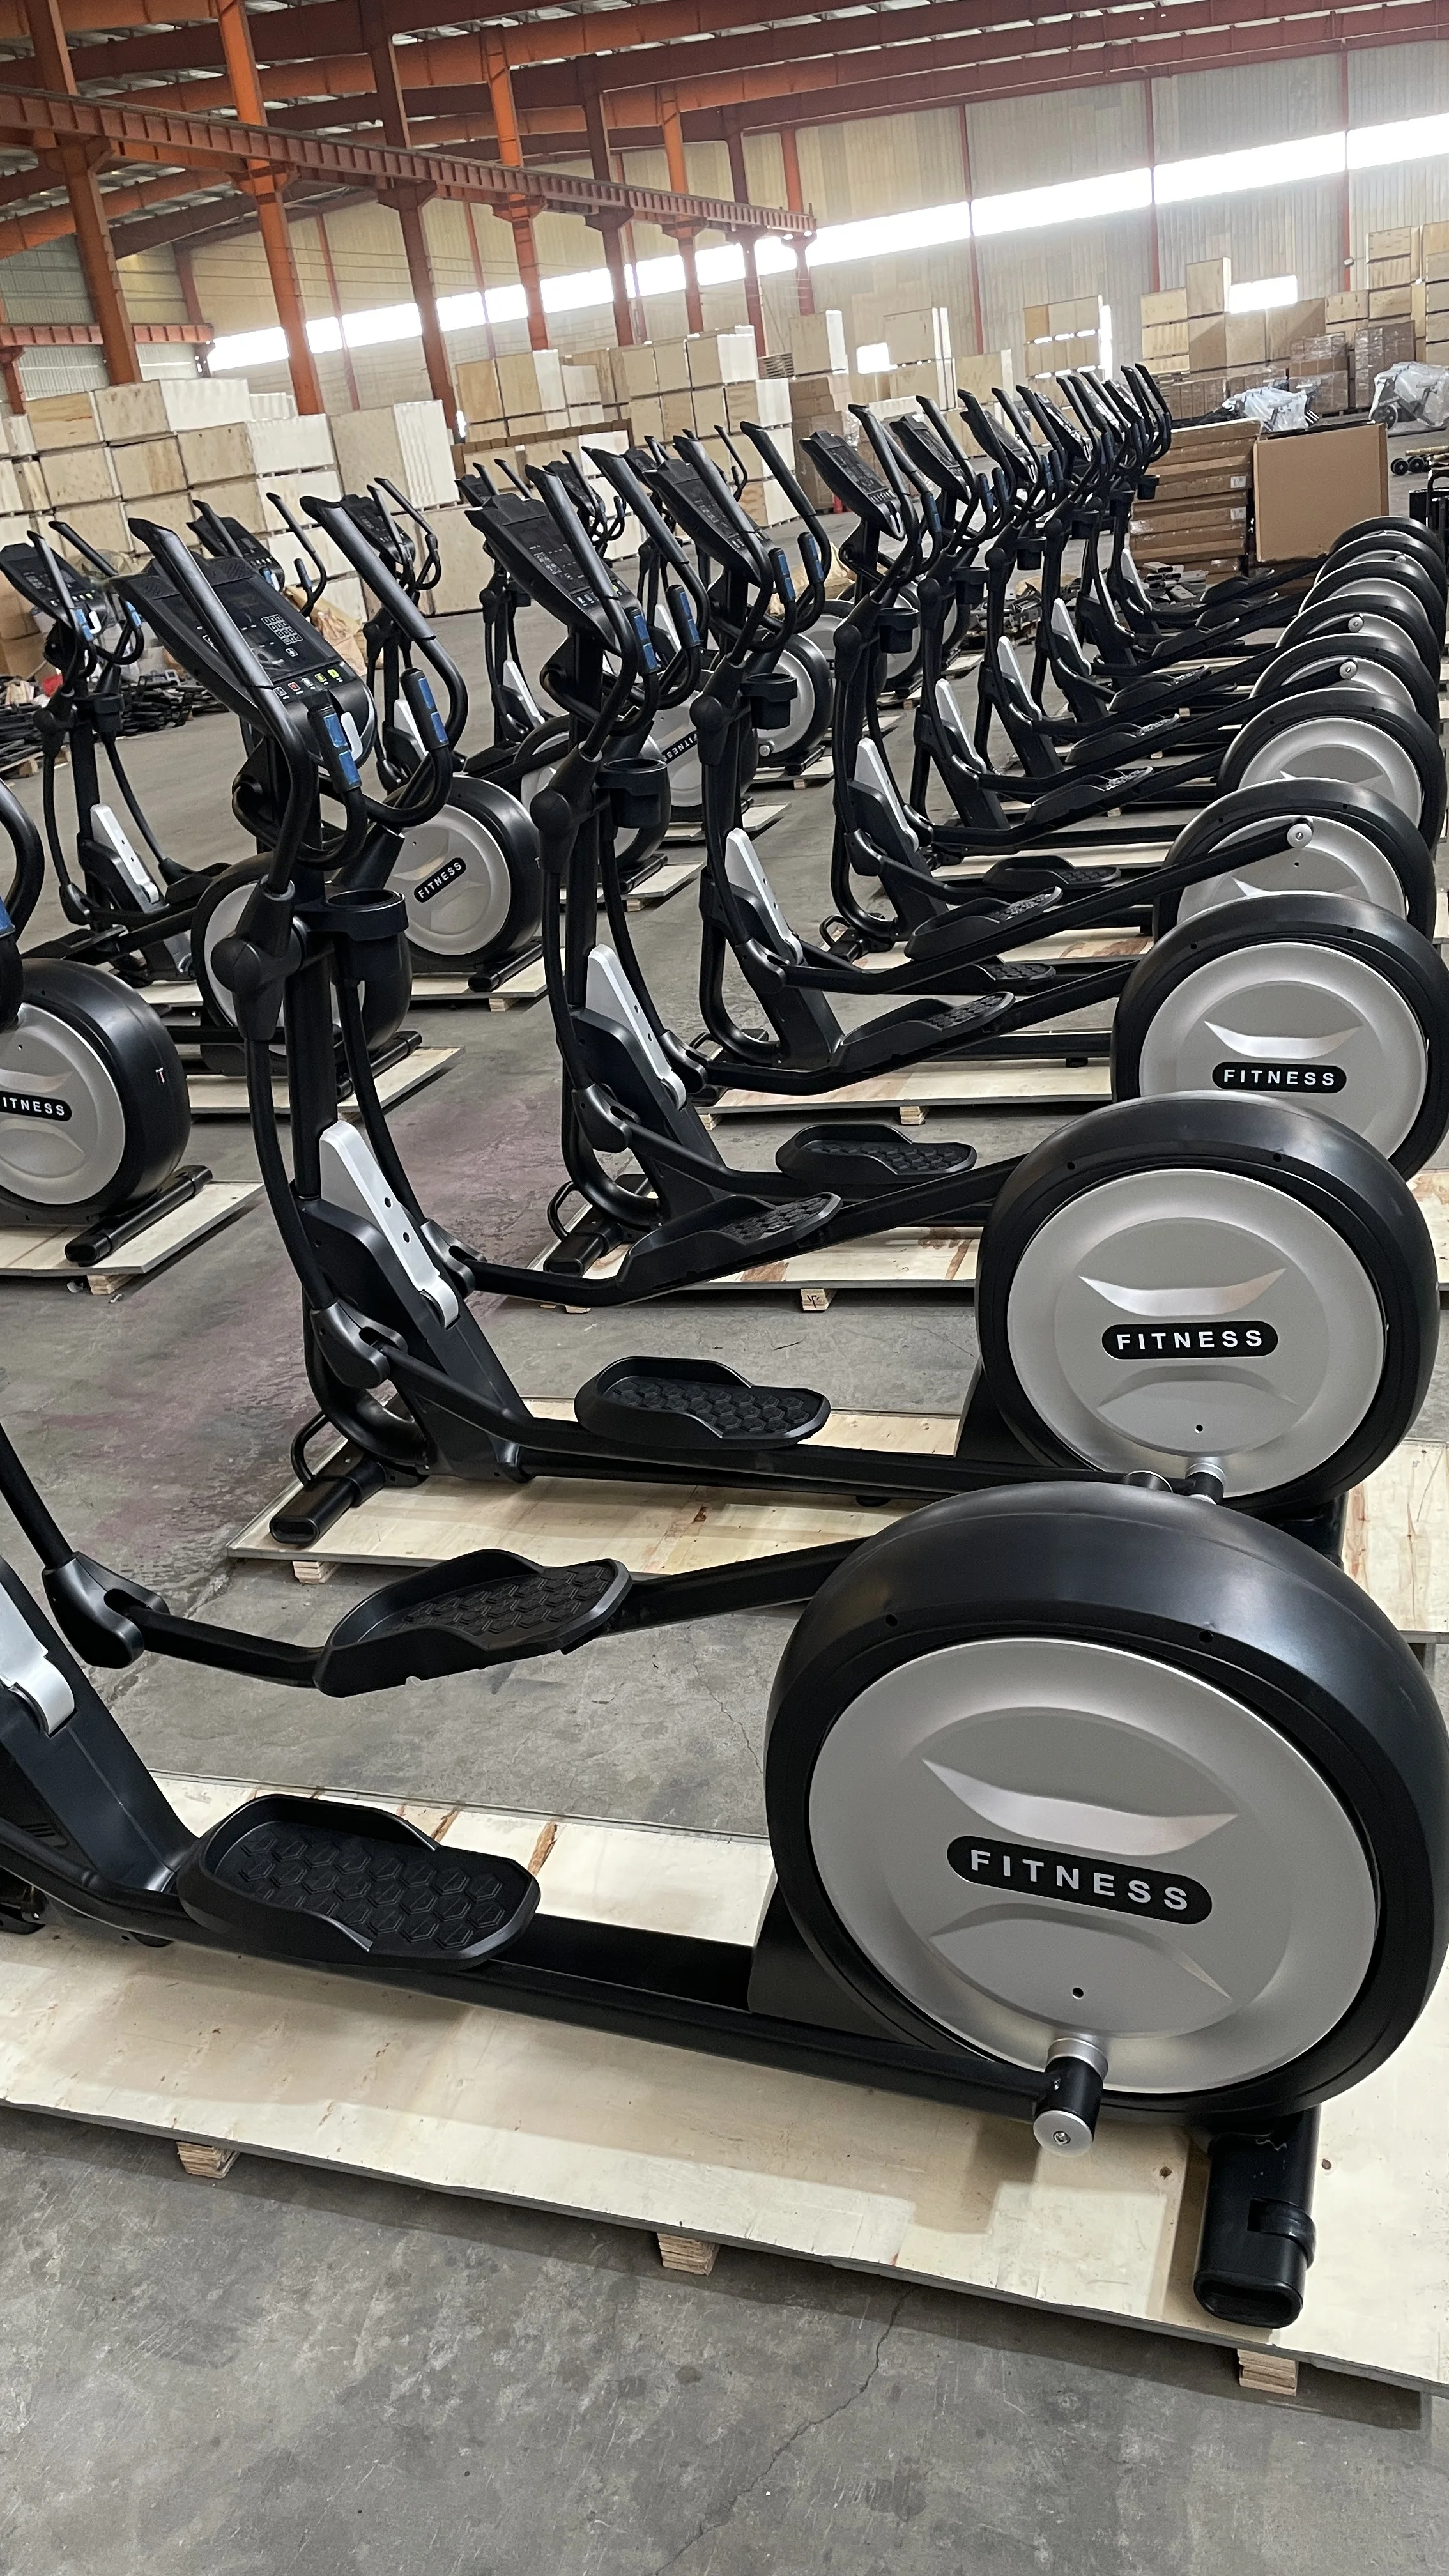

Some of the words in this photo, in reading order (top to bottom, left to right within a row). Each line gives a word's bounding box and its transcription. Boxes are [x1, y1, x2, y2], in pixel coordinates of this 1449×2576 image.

[418, 862, 461, 898] FITNESS
[1223, 1069, 1334, 1085] FITNESS
[3, 1096, 65, 1116] ITNESS
[1117, 1330, 1262, 1350] FITNESS
[970, 1849, 1188, 1910] FITNESS
